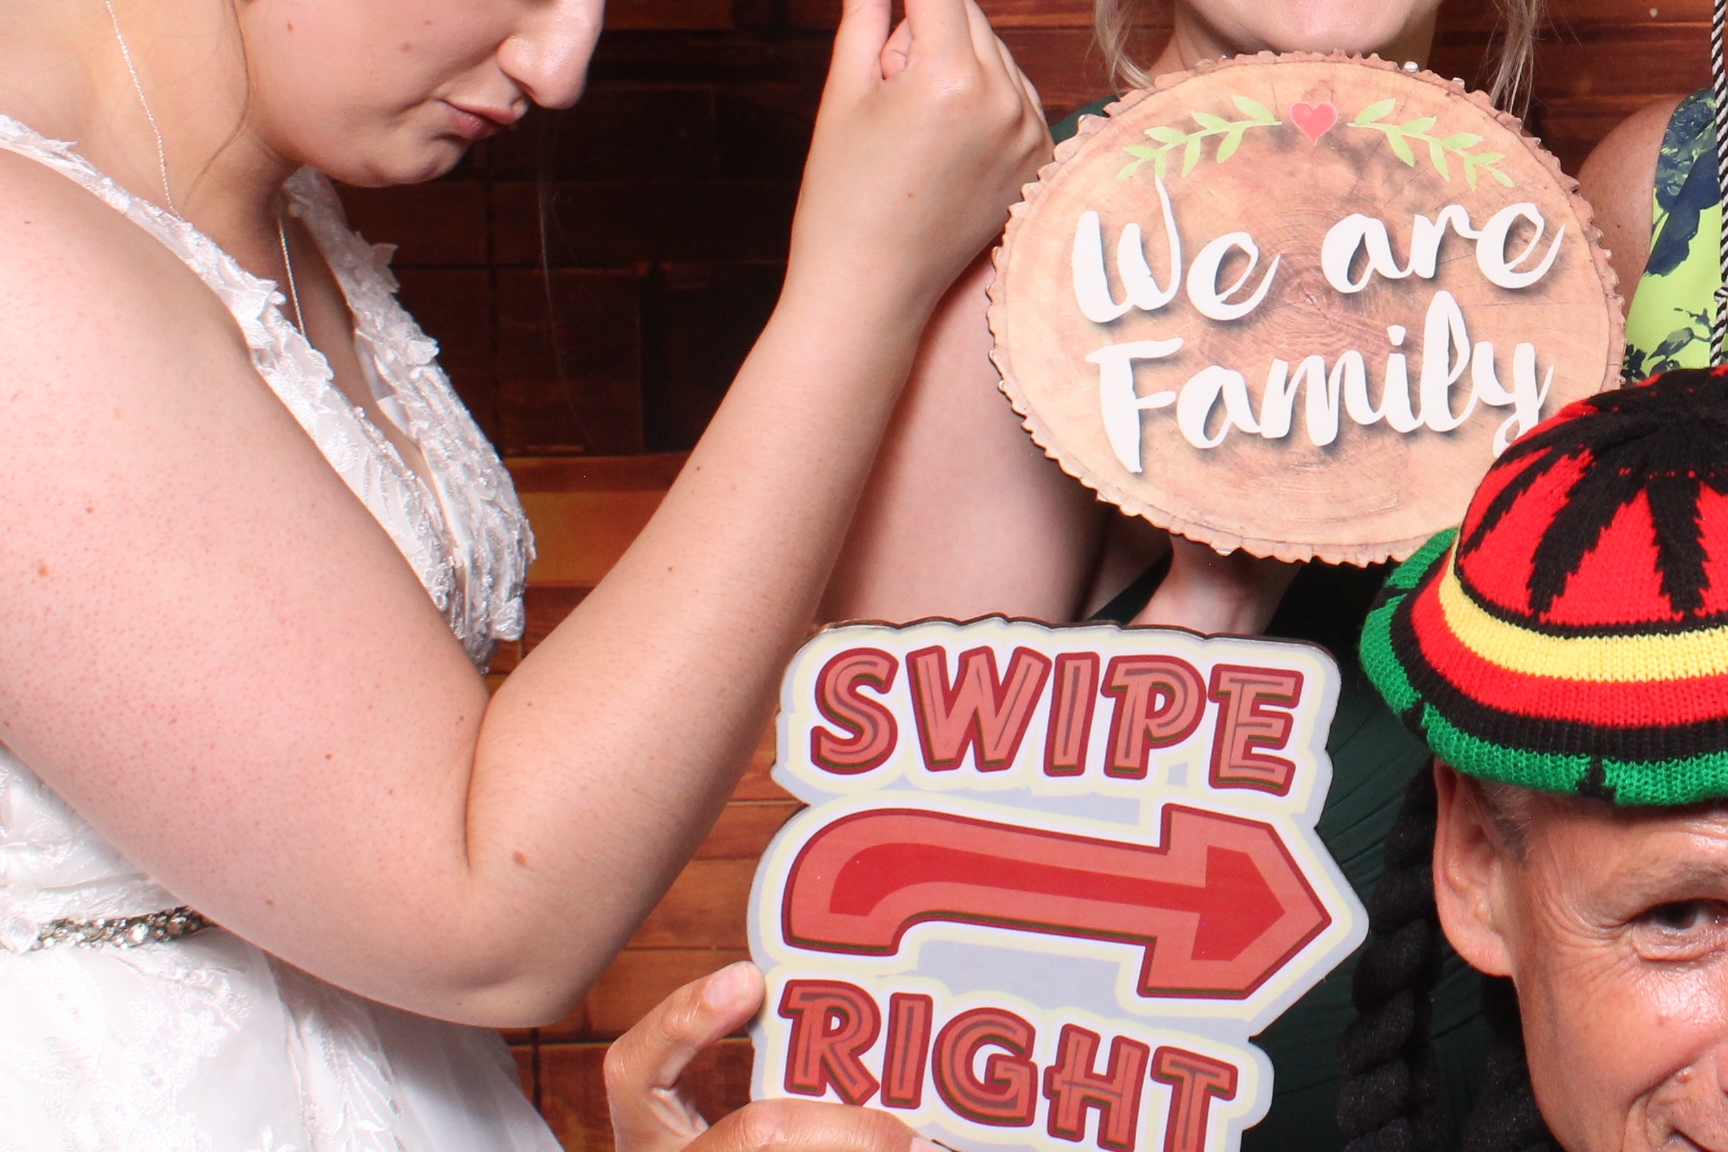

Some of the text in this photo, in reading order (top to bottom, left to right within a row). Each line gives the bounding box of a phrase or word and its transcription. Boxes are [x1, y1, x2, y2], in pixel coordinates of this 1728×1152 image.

[1071, 175, 1566, 323] We are
[1085, 290, 1555, 474] Family
[810, 645, 1304, 797] SWIPE
[778, 979, 1239, 1152] RIGHT
